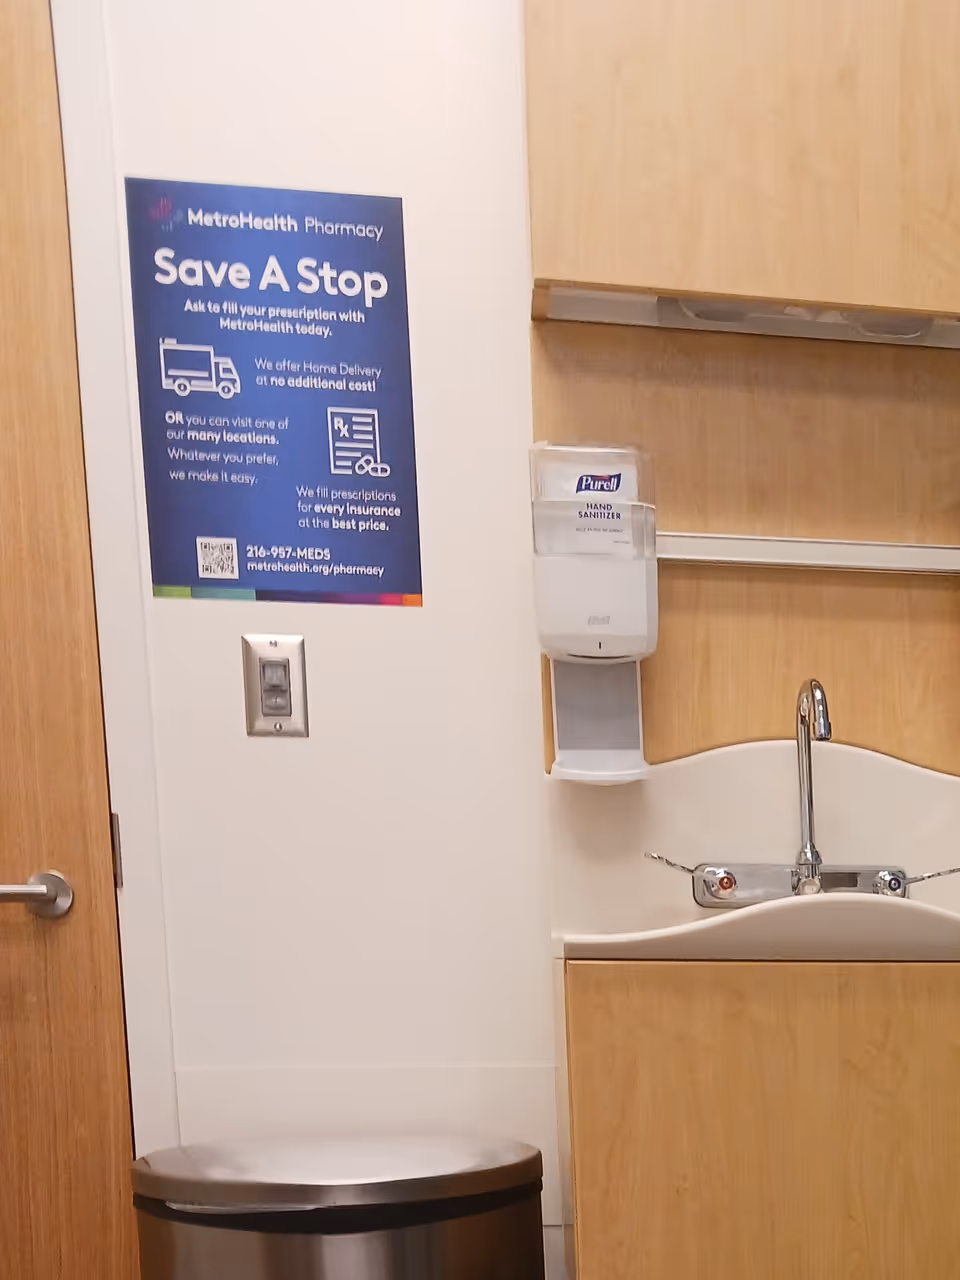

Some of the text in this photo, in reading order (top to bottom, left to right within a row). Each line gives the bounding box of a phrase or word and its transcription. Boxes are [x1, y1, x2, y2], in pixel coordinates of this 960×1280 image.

[188, 208, 384, 242] MetroHealth Pharmacy
[154, 247, 388, 308] Save A Stop
[184, 298, 365, 323] Ask to fill your prescription with
[220, 316, 332, 338] MetroHealth today.
[254, 358, 382, 380] We offer Home Delivery
[256, 376, 376, 392] at no additional cost!
[165, 410, 290, 430] OR you can visit one of
[166, 429, 280, 445] our many locations.
[167, 446, 279, 466] Whatever you prefer,
[169, 468, 258, 486] we make it easy.
[582, 476, 618, 492] Purell
[296, 486, 396, 503] We fill prescriptions
[297, 500, 401, 517] for every insurance
[578, 510, 621, 520] SANITIZER
[586, 502, 613, 511] HAND
[298, 516, 390, 532] at the best price.
[246, 545, 331, 560] 216-957-MEDS
[247, 560, 385, 578] metrohealth.org/pharmacy
